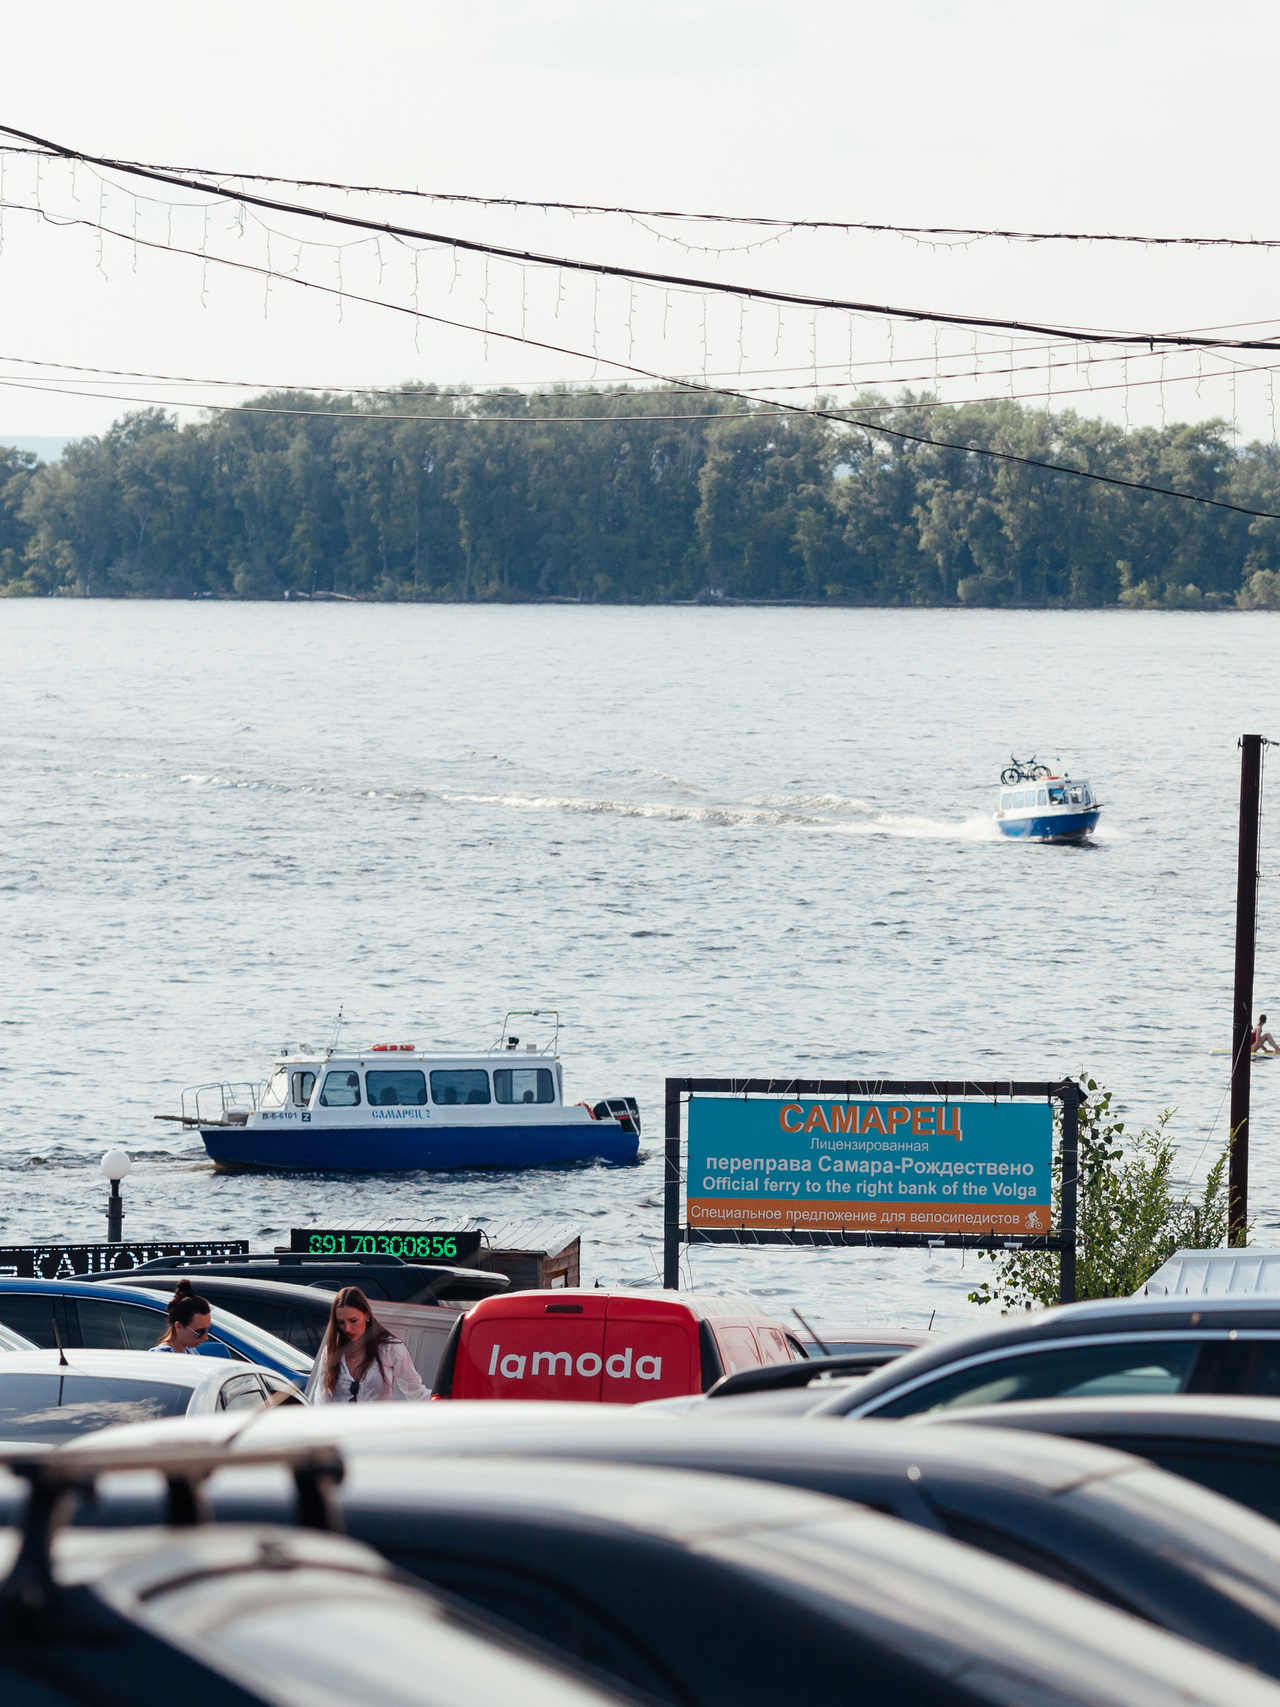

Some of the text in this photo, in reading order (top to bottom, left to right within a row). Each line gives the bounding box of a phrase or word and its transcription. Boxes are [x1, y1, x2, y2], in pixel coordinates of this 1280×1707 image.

[371, 1109, 431, 1120] САМАРЕЦ 2
[779, 1103, 963, 1141] САМАРЕЦ
[810, 1137, 929, 1152] Лицензированная
[706, 1155, 1034, 1178] переправа Самара-Рождествено
[702, 1176, 1037, 1200] Official ferry to the right bank of the Volga
[690, 1205, 1020, 1228] Специальное предложение для велосипедистов
[488, 1344, 662, 1380] lamoda
